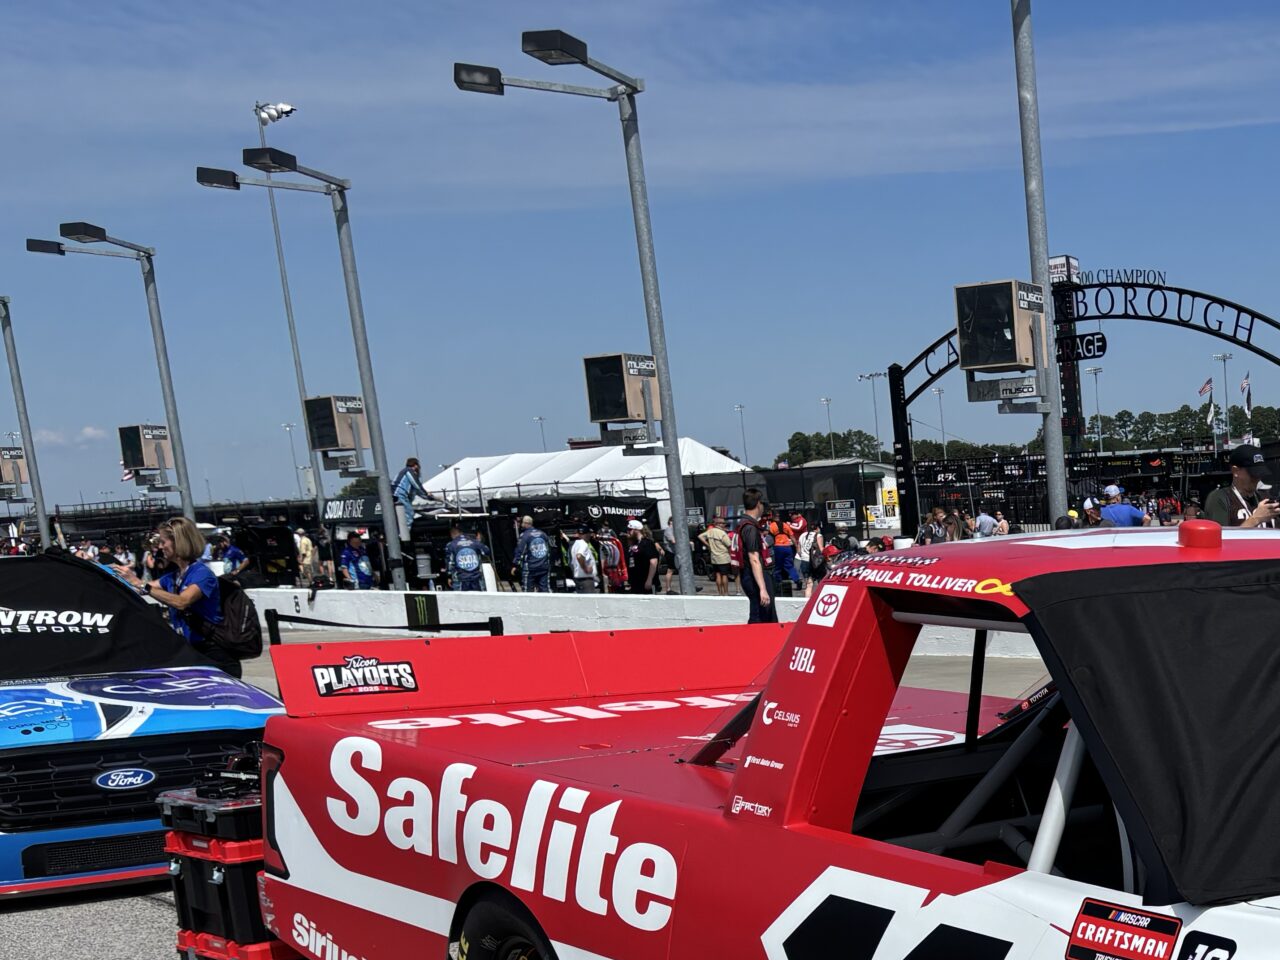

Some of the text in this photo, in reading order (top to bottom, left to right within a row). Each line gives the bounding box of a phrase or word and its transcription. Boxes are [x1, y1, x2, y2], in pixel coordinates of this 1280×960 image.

[1077, 272, 1094, 285] 500
[1097, 269, 1167, 286] CHAMPION
[325, 500, 344, 519] SODA
[344, 498, 365, 518] SENSE
[603, 506, 646, 517] TRACKHOUSE
[859, 568, 978, 593] PAULA TOLLIVER
[344, 656, 378, 669] Tricon
[789, 647, 816, 674] JBL
[313, 664, 416, 695] PLAYOFFS
[1029, 687, 1049, 704] TOYOTA
[773, 710, 801, 725] CELSIUS
[108, 770, 143, 787] Ford
[326, 736, 679, 932] Safelite
[1117, 911, 1151, 929] NASCAR
[1076, 921, 1168, 960] CRAFTSMAN
